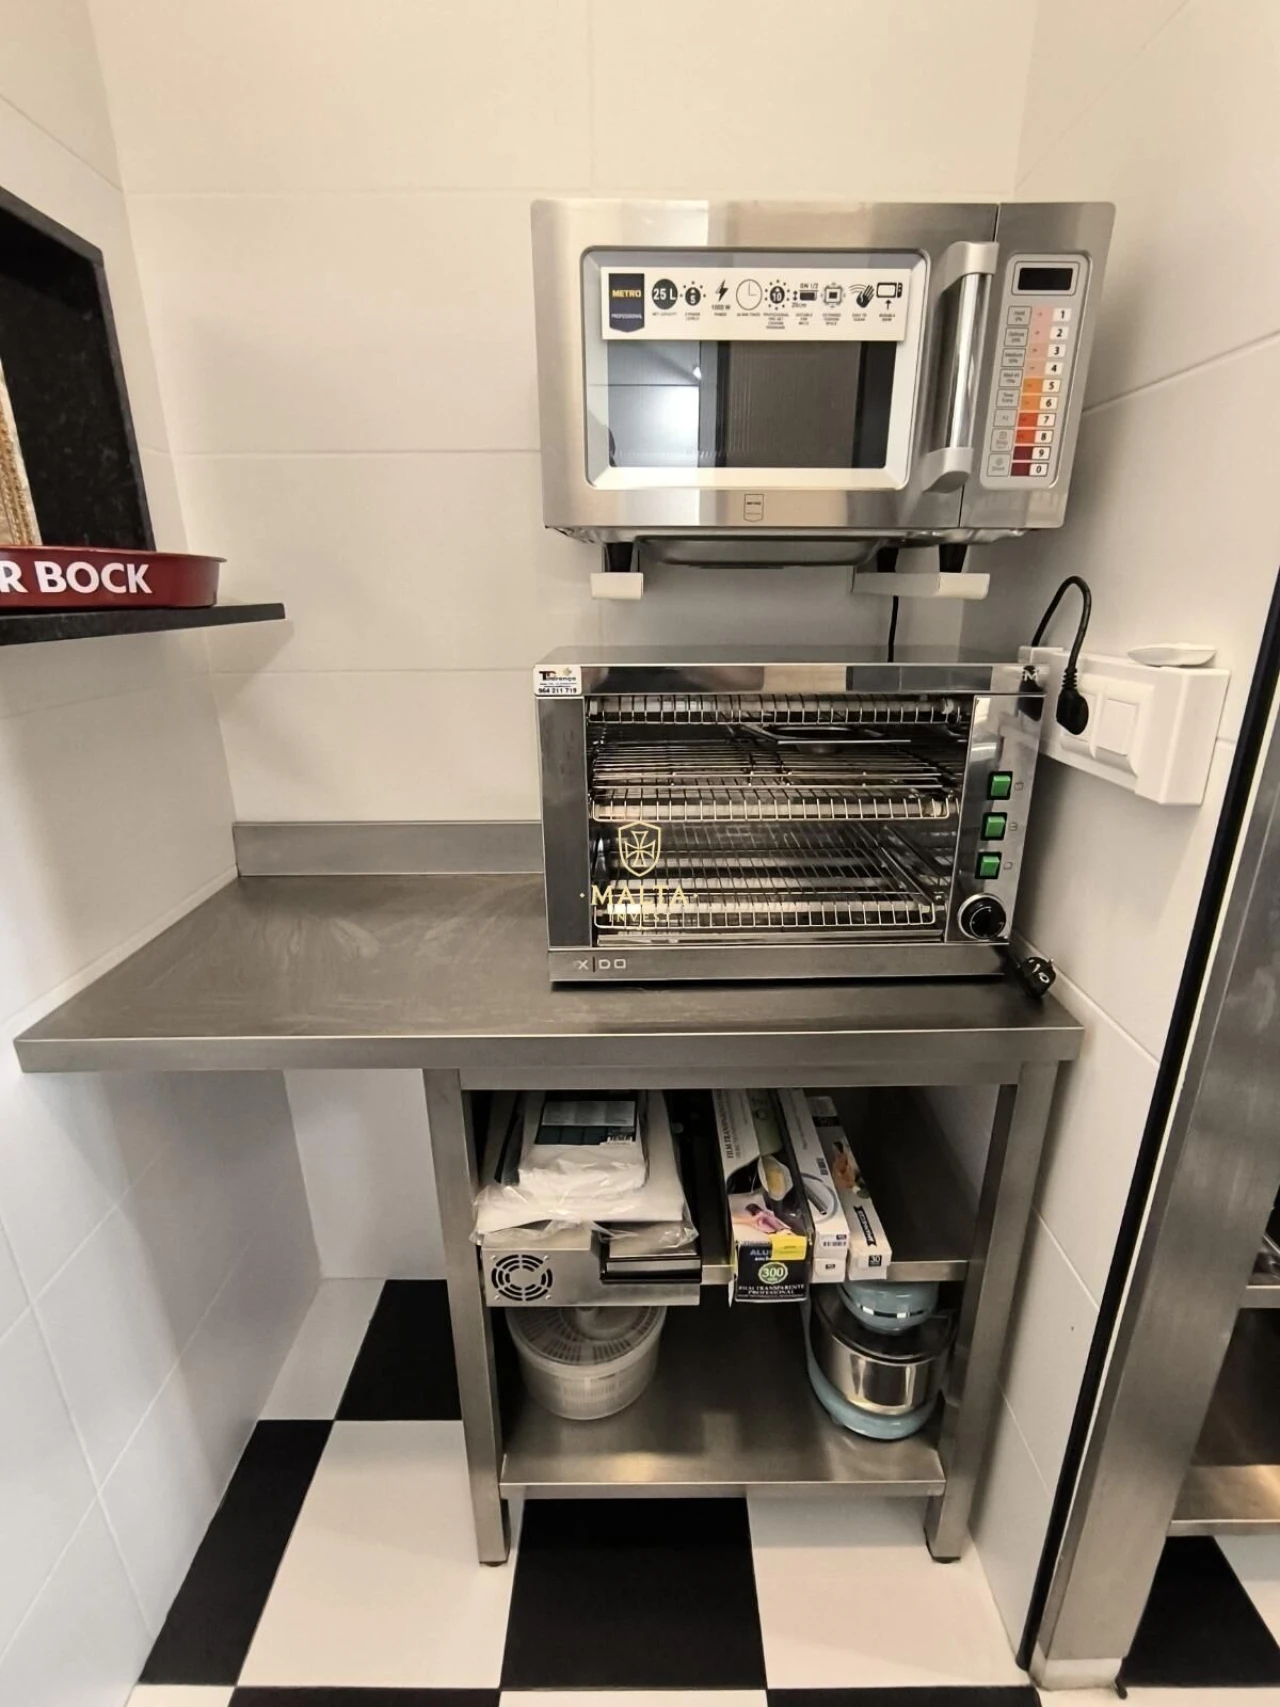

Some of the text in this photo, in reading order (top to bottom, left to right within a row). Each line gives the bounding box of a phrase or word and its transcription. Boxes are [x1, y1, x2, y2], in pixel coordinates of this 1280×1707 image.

[612, 289, 642, 298] METRO
[653, 288, 677, 300] 25 L
[772, 293, 782, 302] 10
[690, 295, 696, 304] 5
[1060, 311, 1065, 319] 1
[1056, 329, 1063, 337] 2
[1054, 346, 1060, 355] 3
[1051, 364, 1057, 372] 4
[1049, 382, 1055, 390] 5
[1046, 399, 1052, 407] 6
[1044, 416, 1050, 424] 7
[1041, 433, 1047, 441] 8
[1038, 449, 1044, 457] 9
[34, 561, 153, 594] BOCK
[870, 1255, 881, 1263] 30
[762, 1267, 784, 1278] 300
